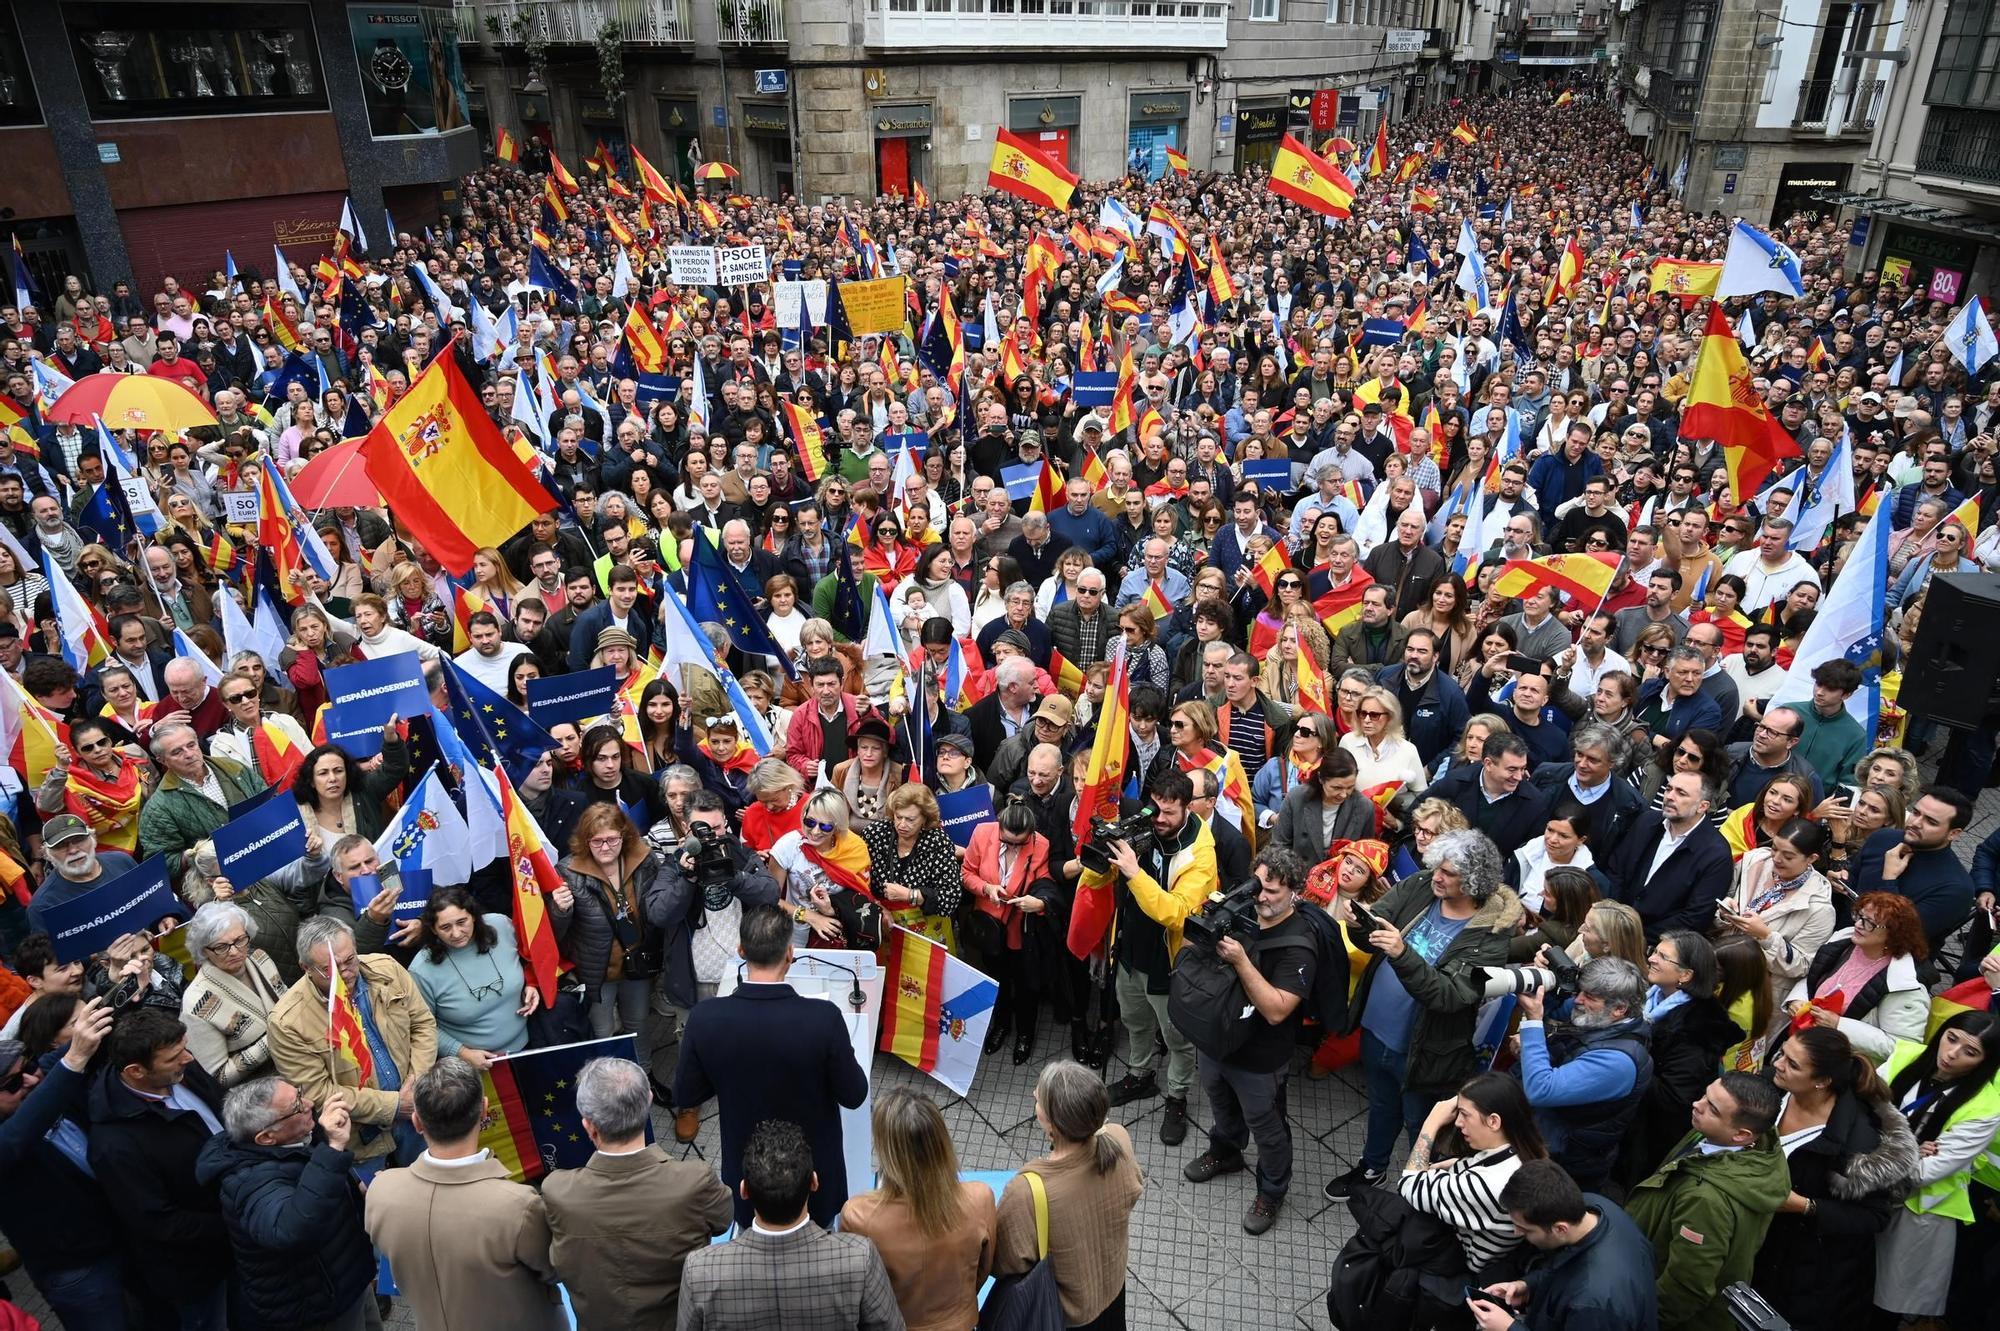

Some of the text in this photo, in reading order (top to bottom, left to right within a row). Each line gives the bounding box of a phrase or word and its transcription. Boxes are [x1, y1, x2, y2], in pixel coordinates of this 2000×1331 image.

[891, 118, 932, 130] Santander
[722, 247, 761, 262] PSOE
[679, 267, 702, 275] TODOS
[723, 275, 730, 284] A
[335, 678, 420, 705] #ESPAÑANOSERINDE
[532, 685, 612, 708] #ESPAÑANOSERINDE
[223, 818, 300, 866] #ESPAÑANOSERINDE
[57, 879, 164, 940] #ESPAÑANOSERINDE
